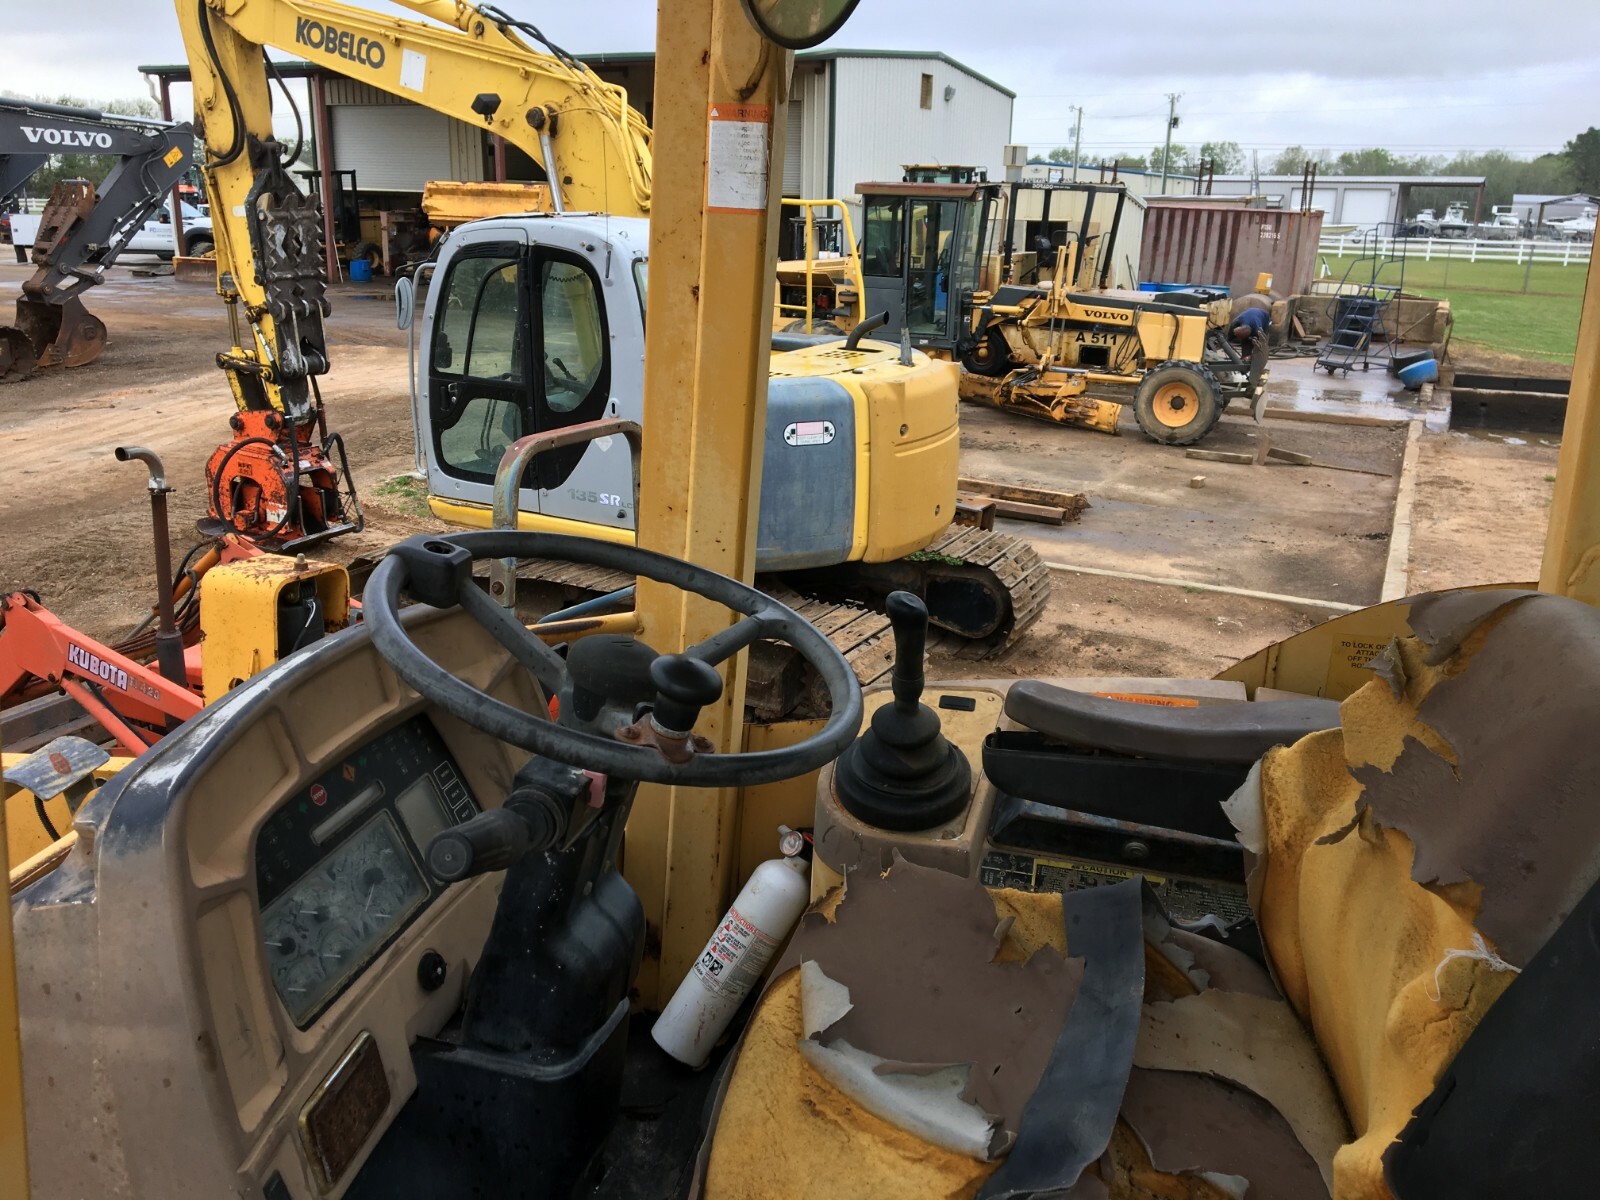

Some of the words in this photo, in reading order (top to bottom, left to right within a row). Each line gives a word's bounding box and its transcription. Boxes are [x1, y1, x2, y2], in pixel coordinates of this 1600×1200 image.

[295, 16, 385, 69] KOBELCO
[20, 126, 112, 148] VOLVO
[1083, 309, 1129, 321] VOLVO
[1075, 331, 1086, 342] A
[1091, 332, 1117, 345] 511
[68, 642, 128, 692] KUBOTA
[313, 789, 324, 800] STOP
